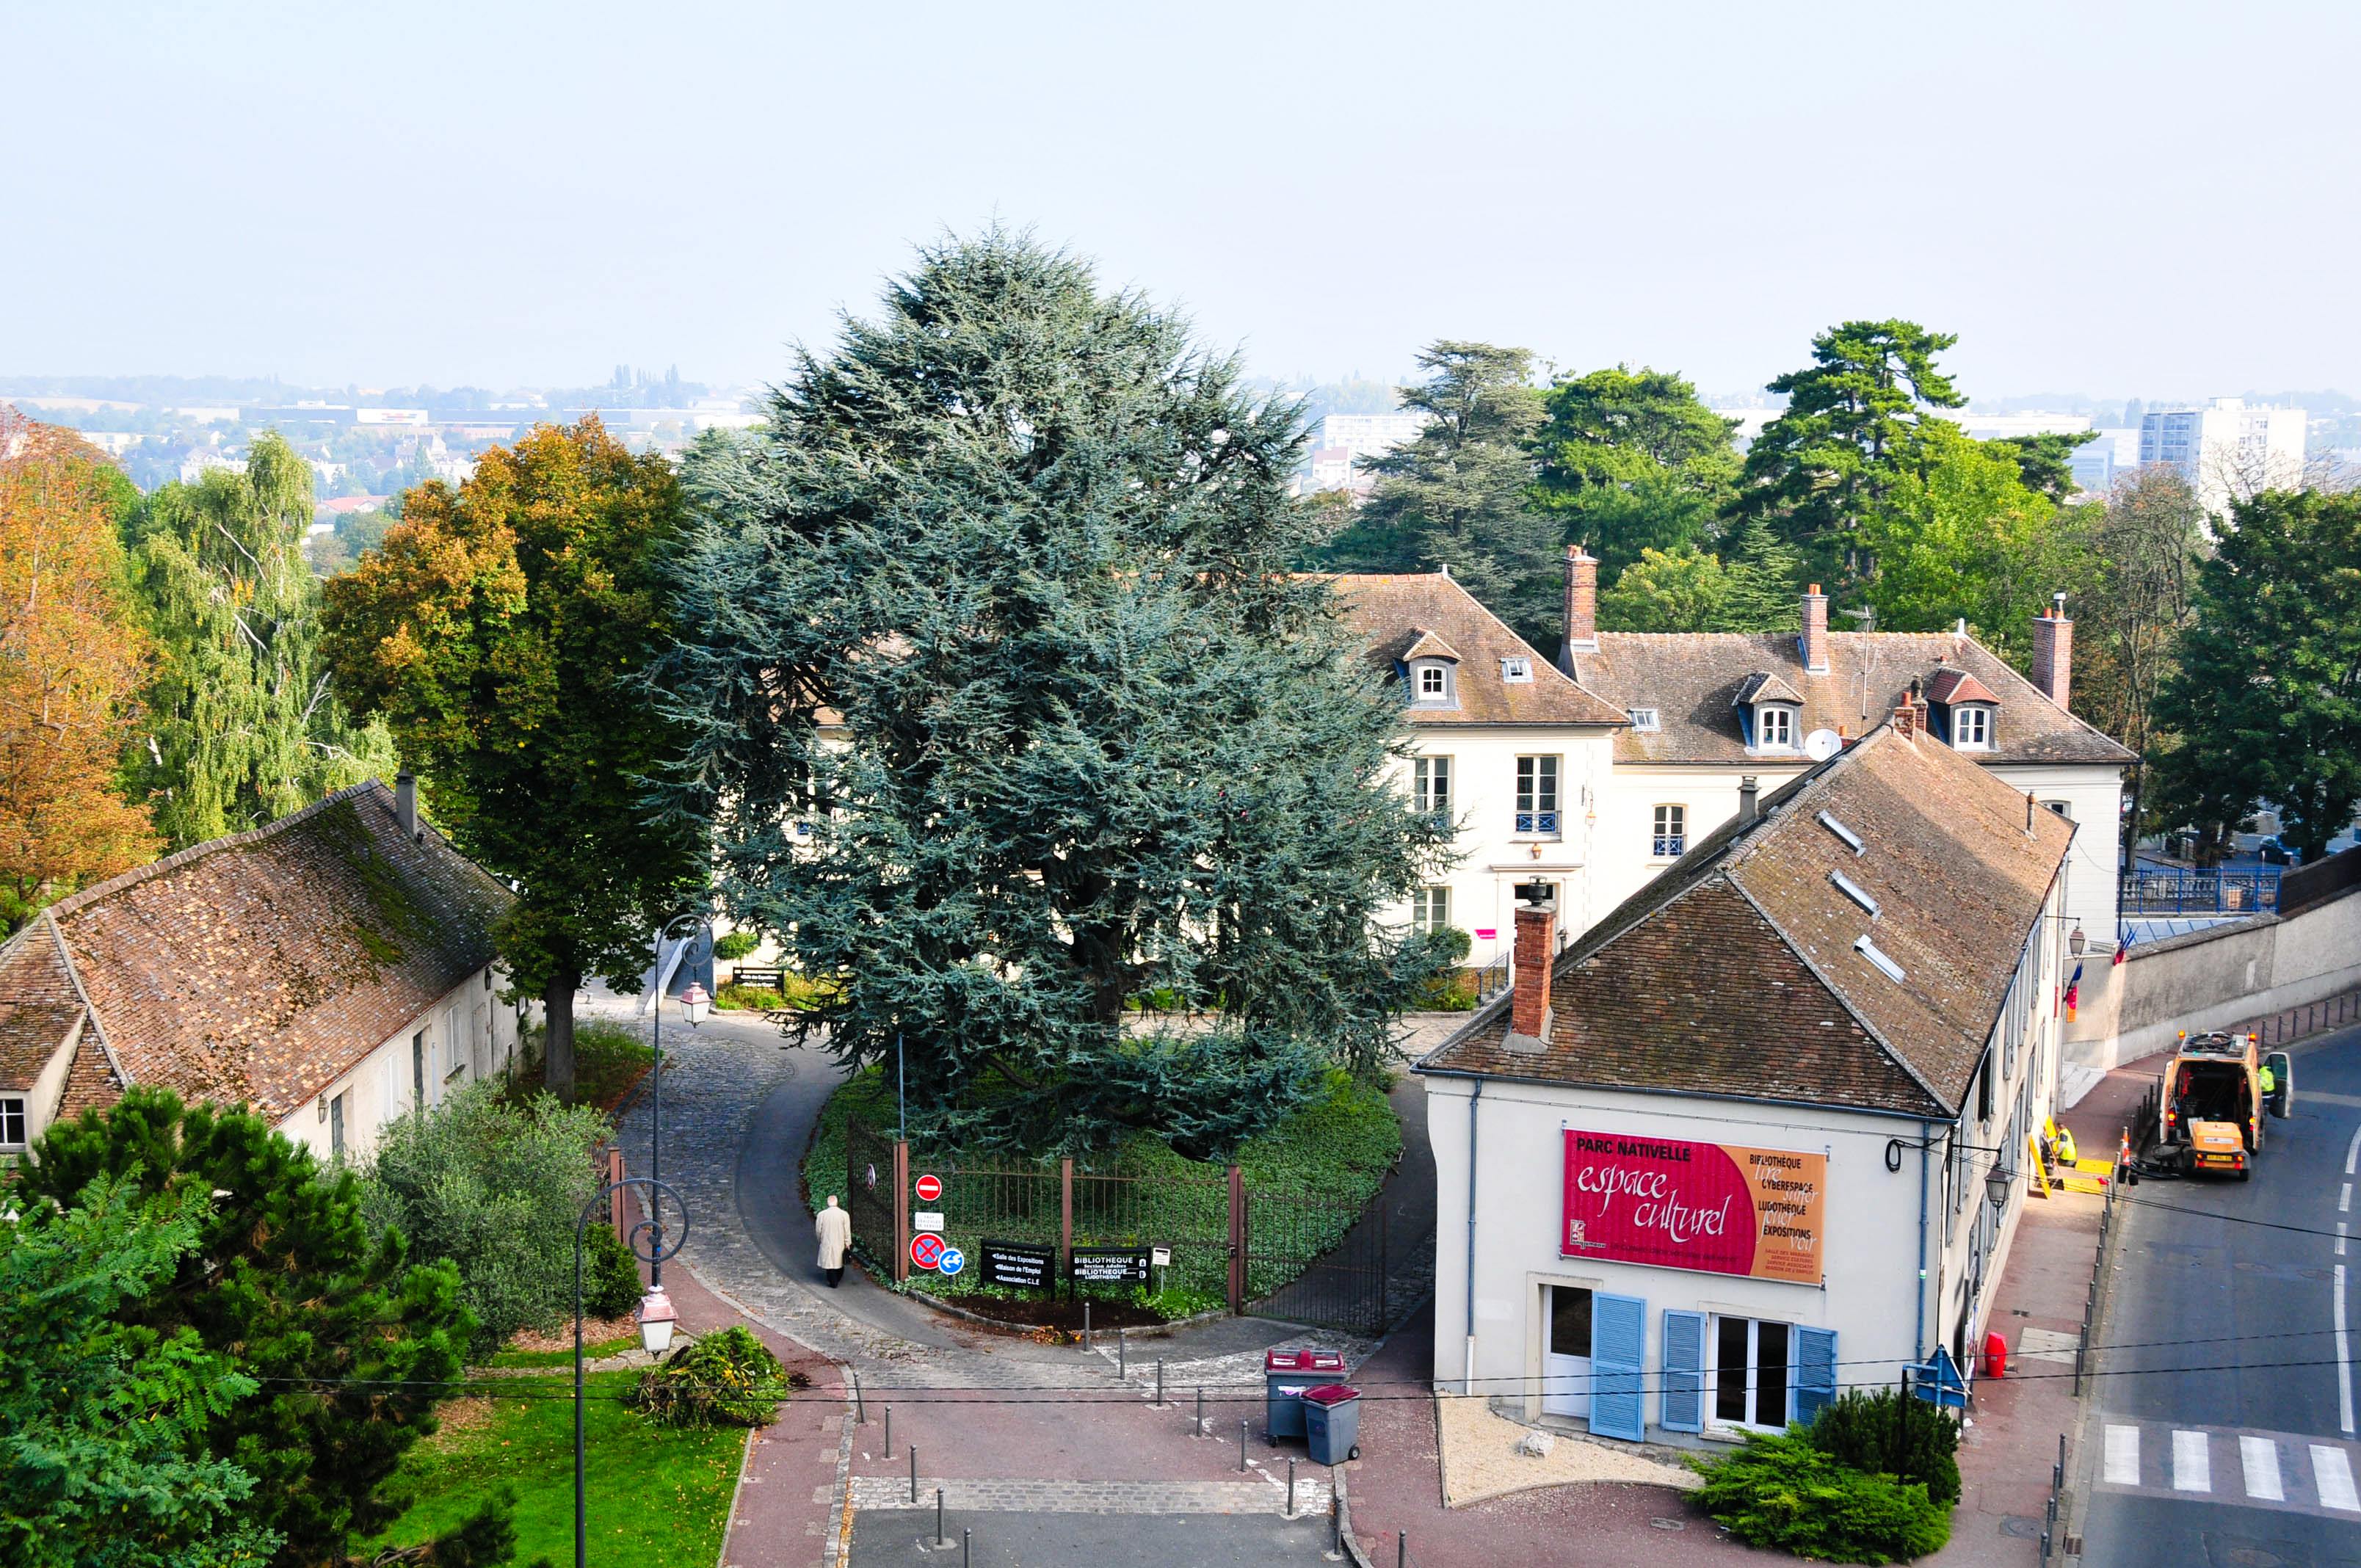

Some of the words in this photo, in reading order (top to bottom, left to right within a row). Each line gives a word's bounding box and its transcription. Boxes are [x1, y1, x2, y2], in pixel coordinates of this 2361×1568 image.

[1577, 1138, 1613, 1154] PARC
[1617, 1141, 1691, 1161] NATIVELLE
[1749, 1154, 1802, 1169] BIBLIOTHÈQUE
[1755, 1157, 1782, 1182] lire
[1578, 1164, 1667, 1217] espace
[1762, 1179, 1813, 1194] CYBERESPACE
[1758, 1200, 1806, 1216] LUDOTHÈQUE
[1634, 1189, 1733, 1243] culturel
[1763, 1225, 1811, 1239] EXPOSITIONS
[1790, 1233, 1818, 1251] voir
[1017, 1256, 1044, 1265] Expositions
[1023, 1266, 1041, 1274] l'Emploi
[1000, 1274, 1026, 1283] Association
